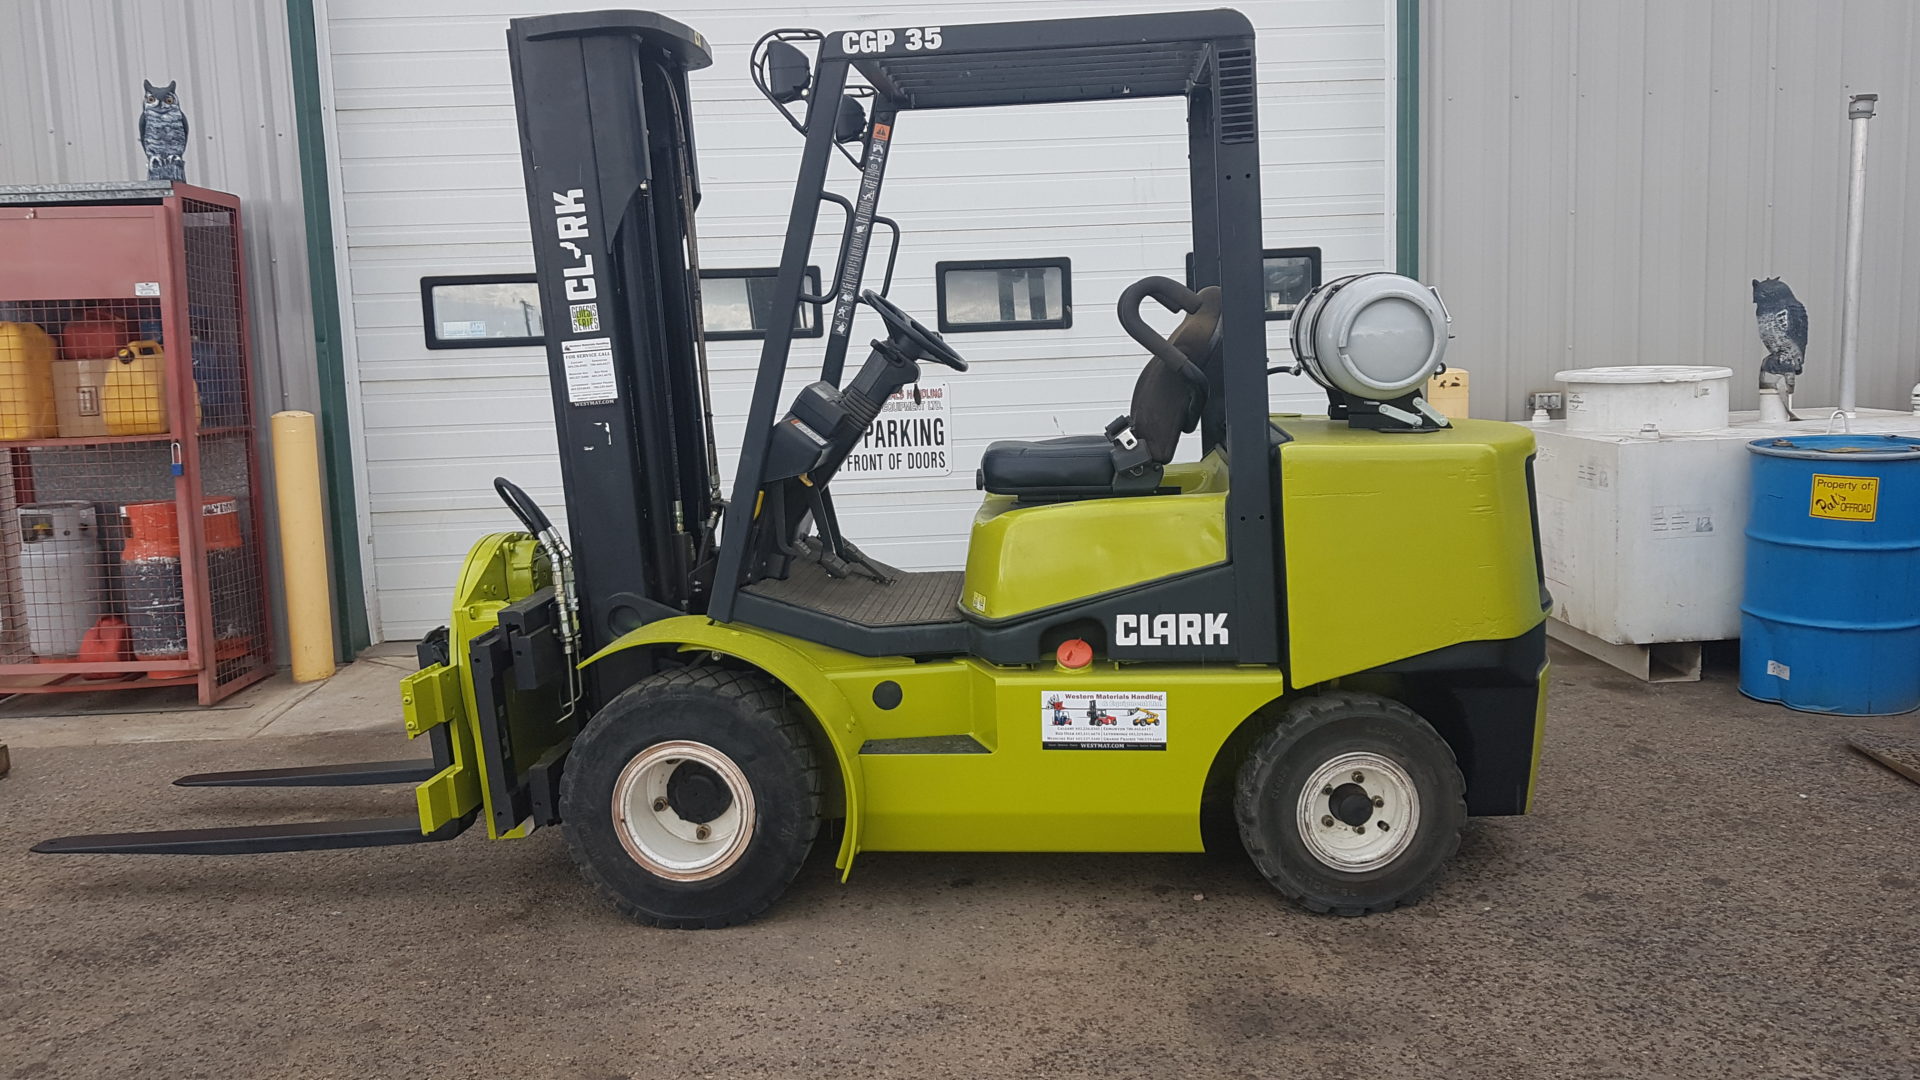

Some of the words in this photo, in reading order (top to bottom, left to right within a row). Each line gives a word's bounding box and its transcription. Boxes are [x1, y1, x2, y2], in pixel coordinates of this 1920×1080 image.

[842, 30, 895, 54] CGP
[905, 27, 942, 51] 35
[571, 304, 597, 318] GENESIS
[573, 317, 599, 331] SERIES
[864, 417, 945, 449] PARKING
[847, 454, 883, 472] FRONT
[889, 453, 903, 470] OF
[908, 451, 946, 469] DOORS
[1817, 479, 1858, 491] Property
[1861, 482, 1874, 491] of:
[1840, 502, 1872, 513] OFFROAD
[1116, 613, 1229, 646] CLARK
[1131, 693, 1163, 701] Handling
